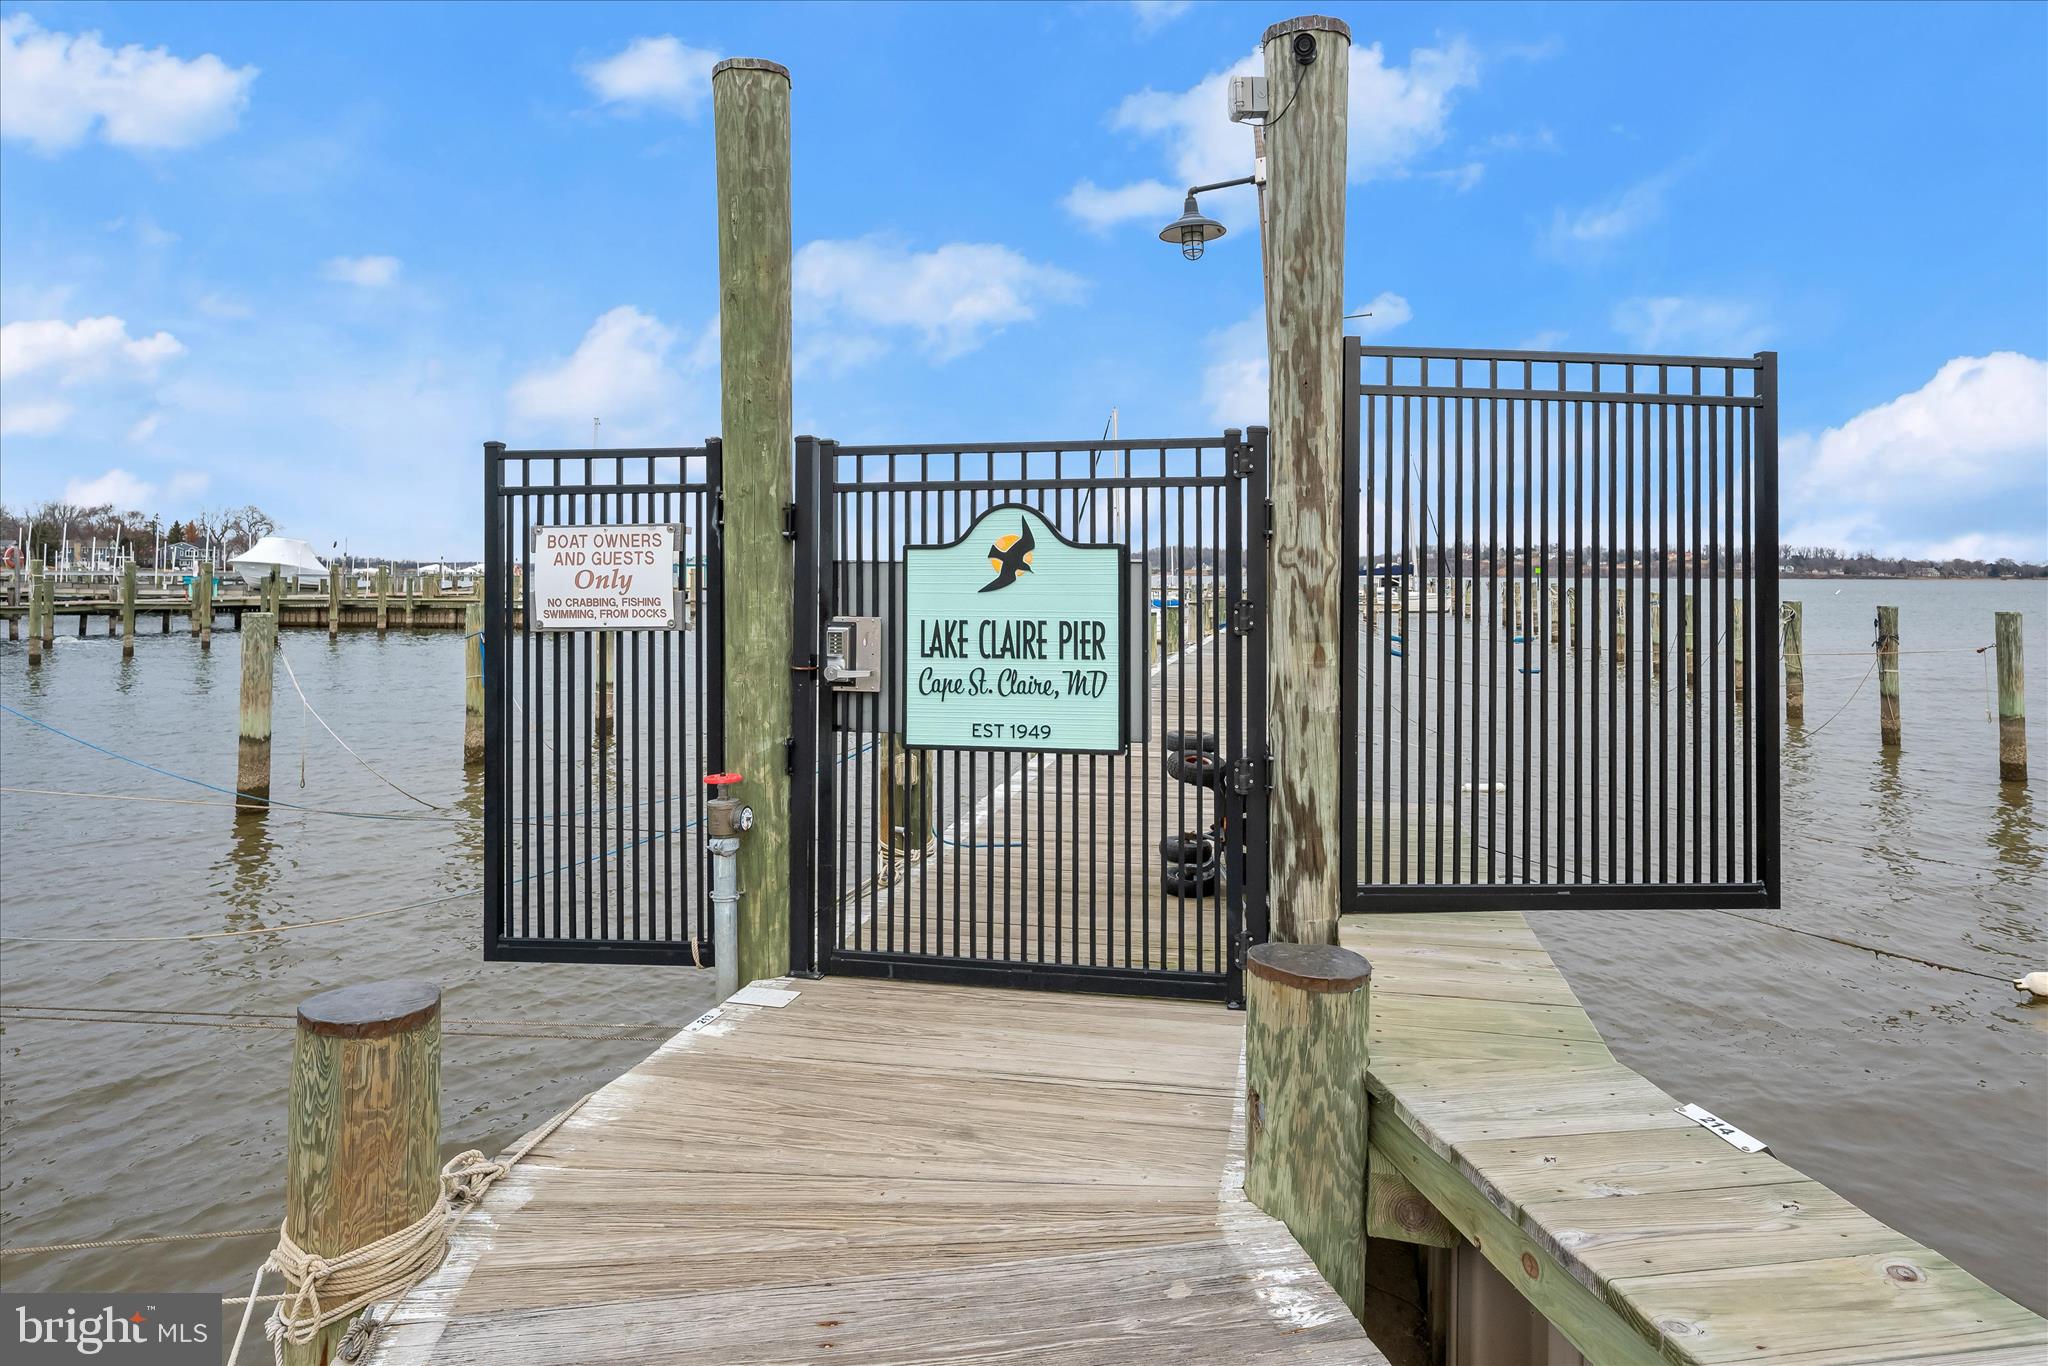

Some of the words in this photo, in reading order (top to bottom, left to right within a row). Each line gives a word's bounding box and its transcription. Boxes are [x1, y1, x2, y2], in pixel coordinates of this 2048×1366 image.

[547, 534, 588, 549] BOAT
[593, 533, 662, 548] OWNERS
[553, 552, 586, 566] AND
[591, 551, 655, 566] GUESTS
[574, 568, 633, 595] Only
[547, 598, 562, 607] NO
[565, 597, 619, 608] CRABBING,
[621, 597, 661, 606] FISHING
[543, 610, 597, 620] SWIMMING,
[599, 609, 629, 619] FROM
[632, 609, 667, 618] DOCKS
[920, 619, 969, 658] LAKE
[978, 619, 1047, 660] CLAIRE
[1059, 620, 1106, 661] PIER
[918, 667, 965, 702] Cape
[968, 667, 993, 696] St.
[997, 668, 1060, 699] Claire,
[1062, 669, 1108, 698] MD
[972, 723, 1004, 738] EST
[1009, 724, 1051, 739] 1949
[1699, 1116, 1735, 1135] 214
